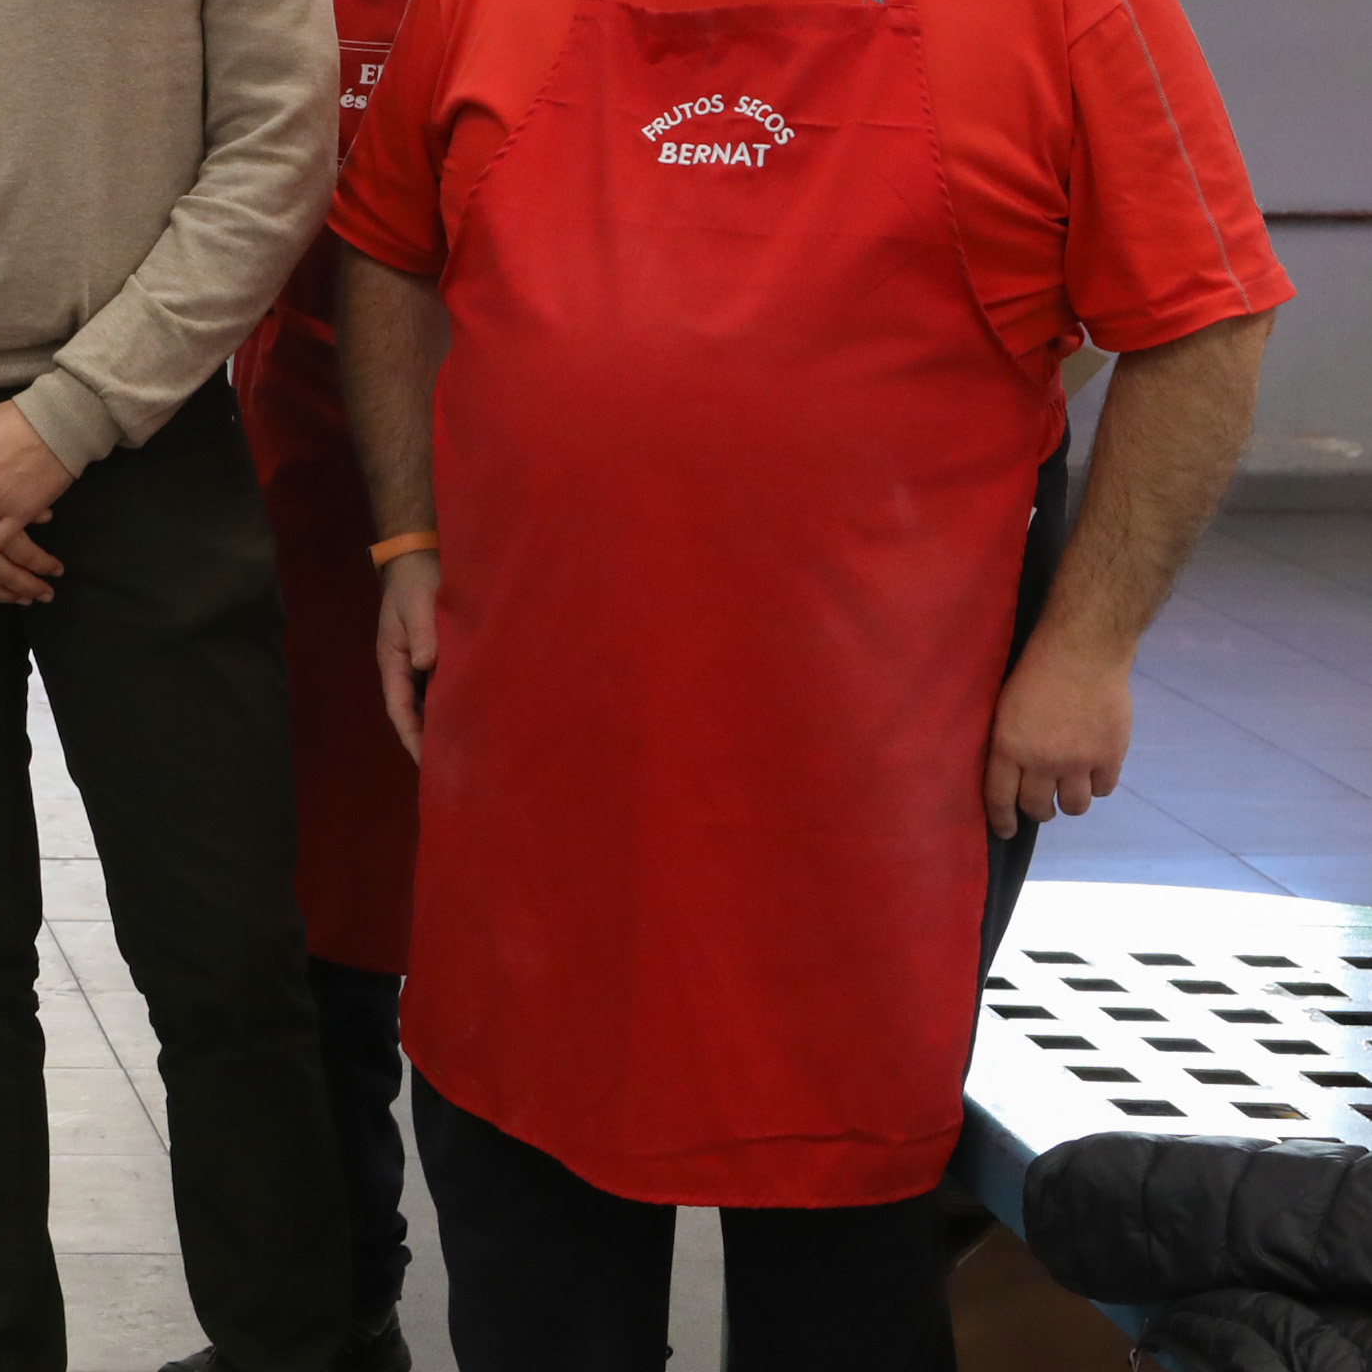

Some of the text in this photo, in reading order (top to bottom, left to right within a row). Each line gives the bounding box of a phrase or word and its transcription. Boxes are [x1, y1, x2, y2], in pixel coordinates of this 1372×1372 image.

[641, 94, 796, 146] FRUTOS SECOS
[657, 141, 772, 168] BERNAT
